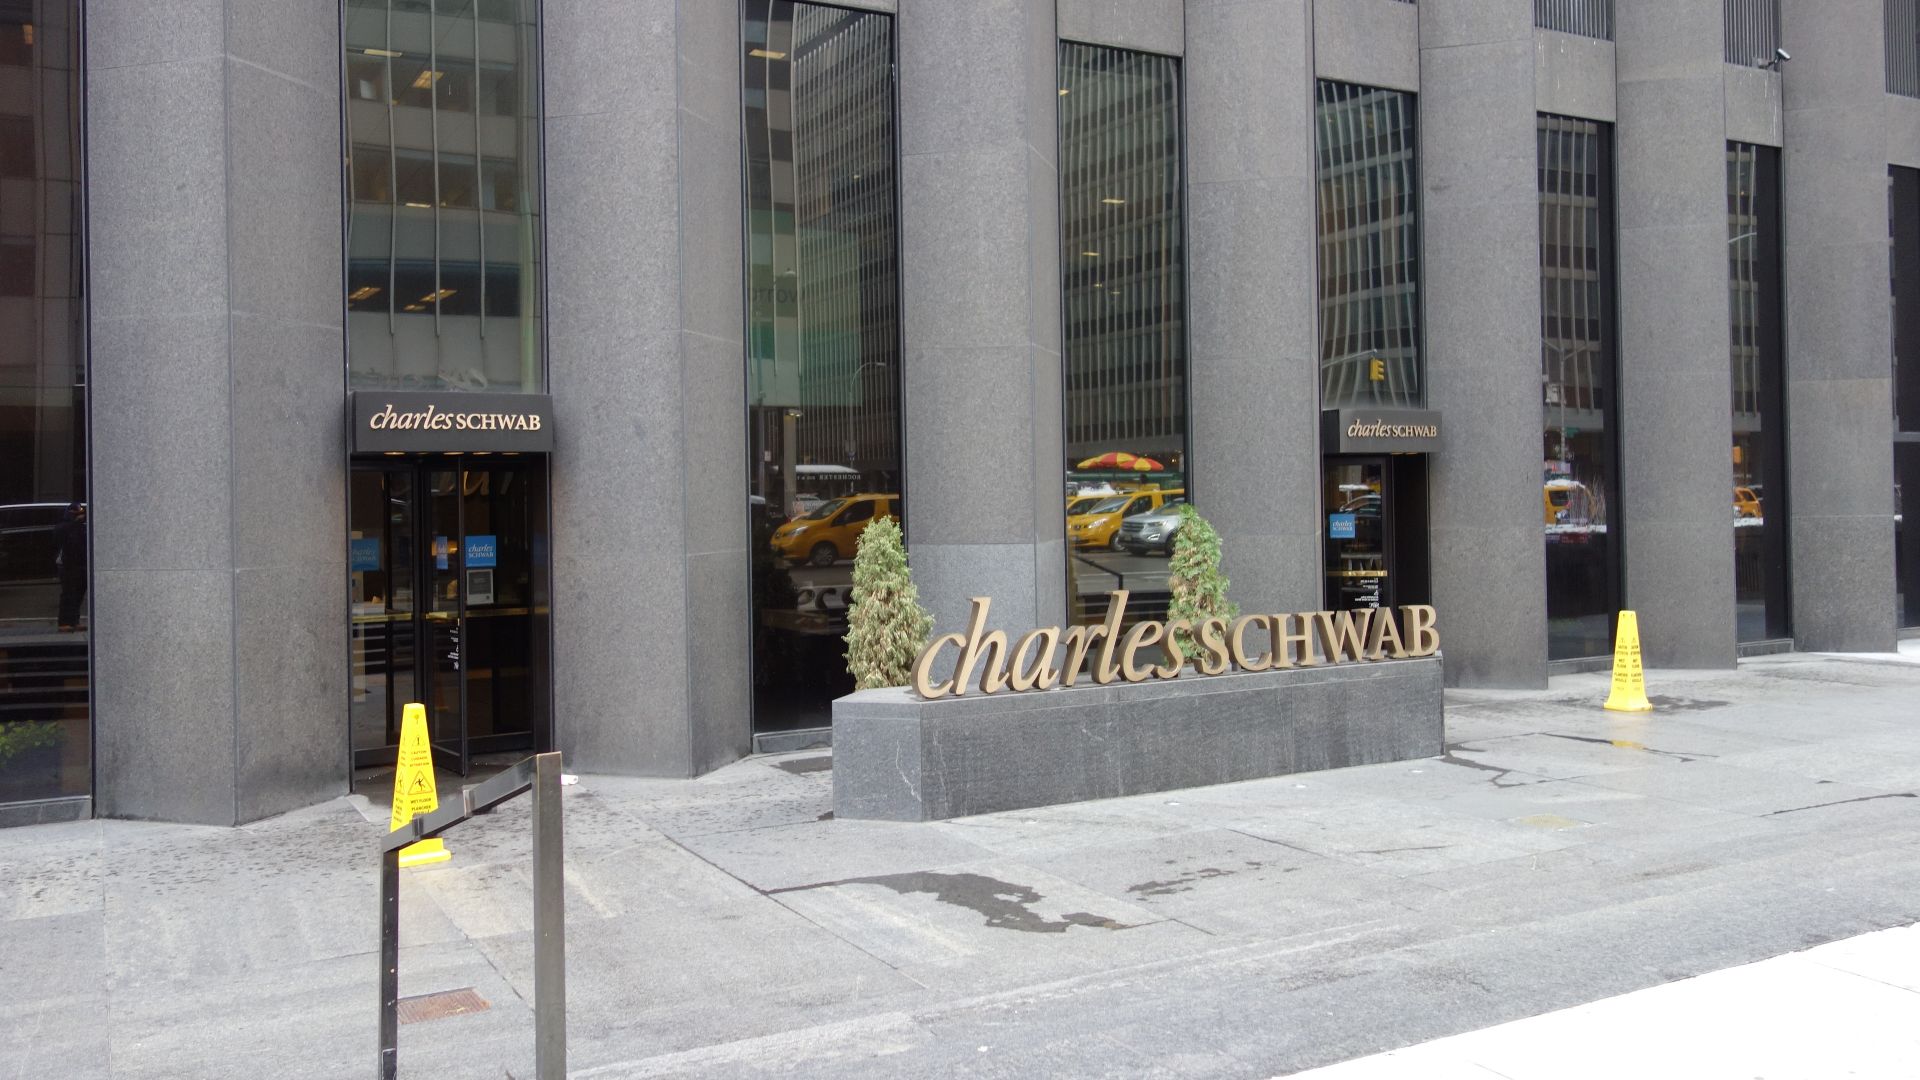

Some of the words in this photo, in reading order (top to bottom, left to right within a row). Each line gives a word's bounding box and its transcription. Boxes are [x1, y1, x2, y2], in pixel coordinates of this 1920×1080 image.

[370, 404, 454, 430] charles
[456, 413, 541, 431] SCHWAB
[1347, 419, 1391, 437] charles
[1392, 425, 1437, 437] SCHWAB
[911, 590, 1191, 699] charles
[1194, 604, 1440, 675] SCHWAB
